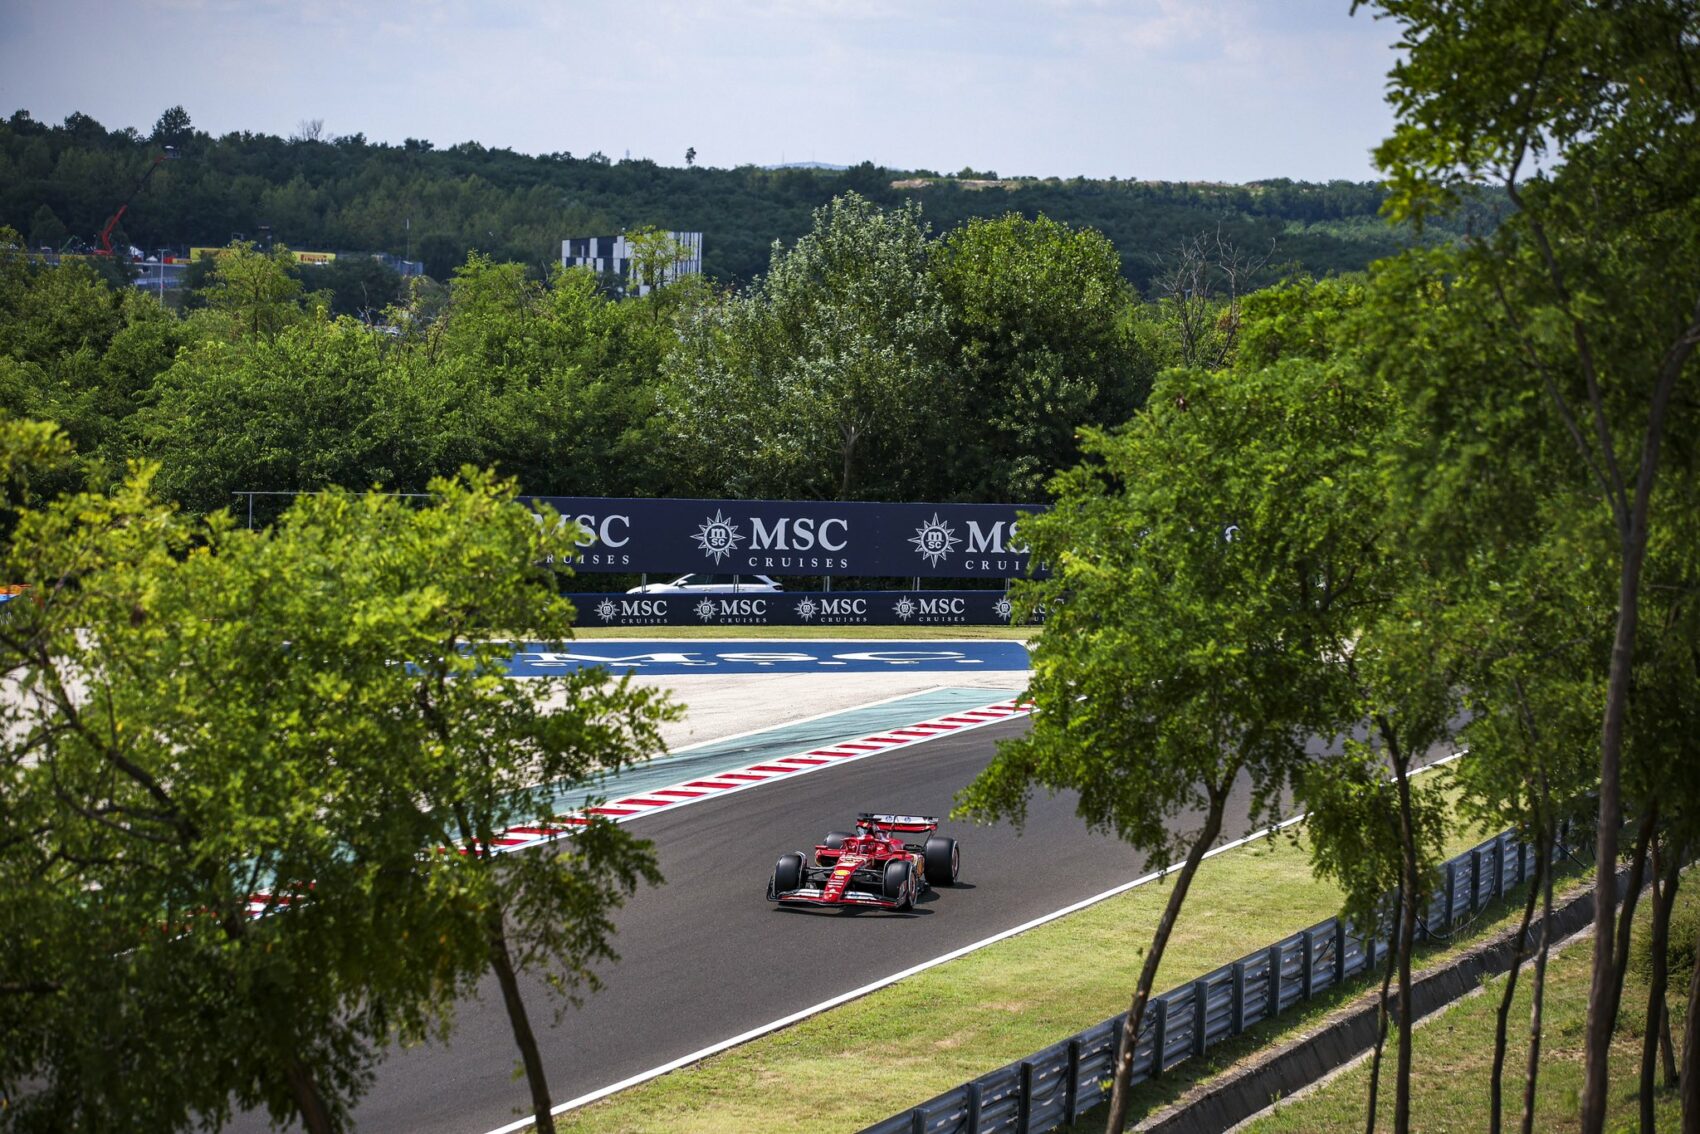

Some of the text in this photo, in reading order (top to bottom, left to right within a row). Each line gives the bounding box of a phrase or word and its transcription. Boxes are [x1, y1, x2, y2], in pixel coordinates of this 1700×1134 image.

[748, 517, 848, 551] MSC
[533, 554, 630, 565] RUISES
[748, 557, 848, 568] CRUISES
[965, 560, 1048, 571] CRUI
[620, 600, 668, 616] MSC
[719, 600, 767, 616] MSC
[820, 598, 867, 614] MSC
[918, 598, 965, 614] MSC
[516, 652, 966, 662] MSC
